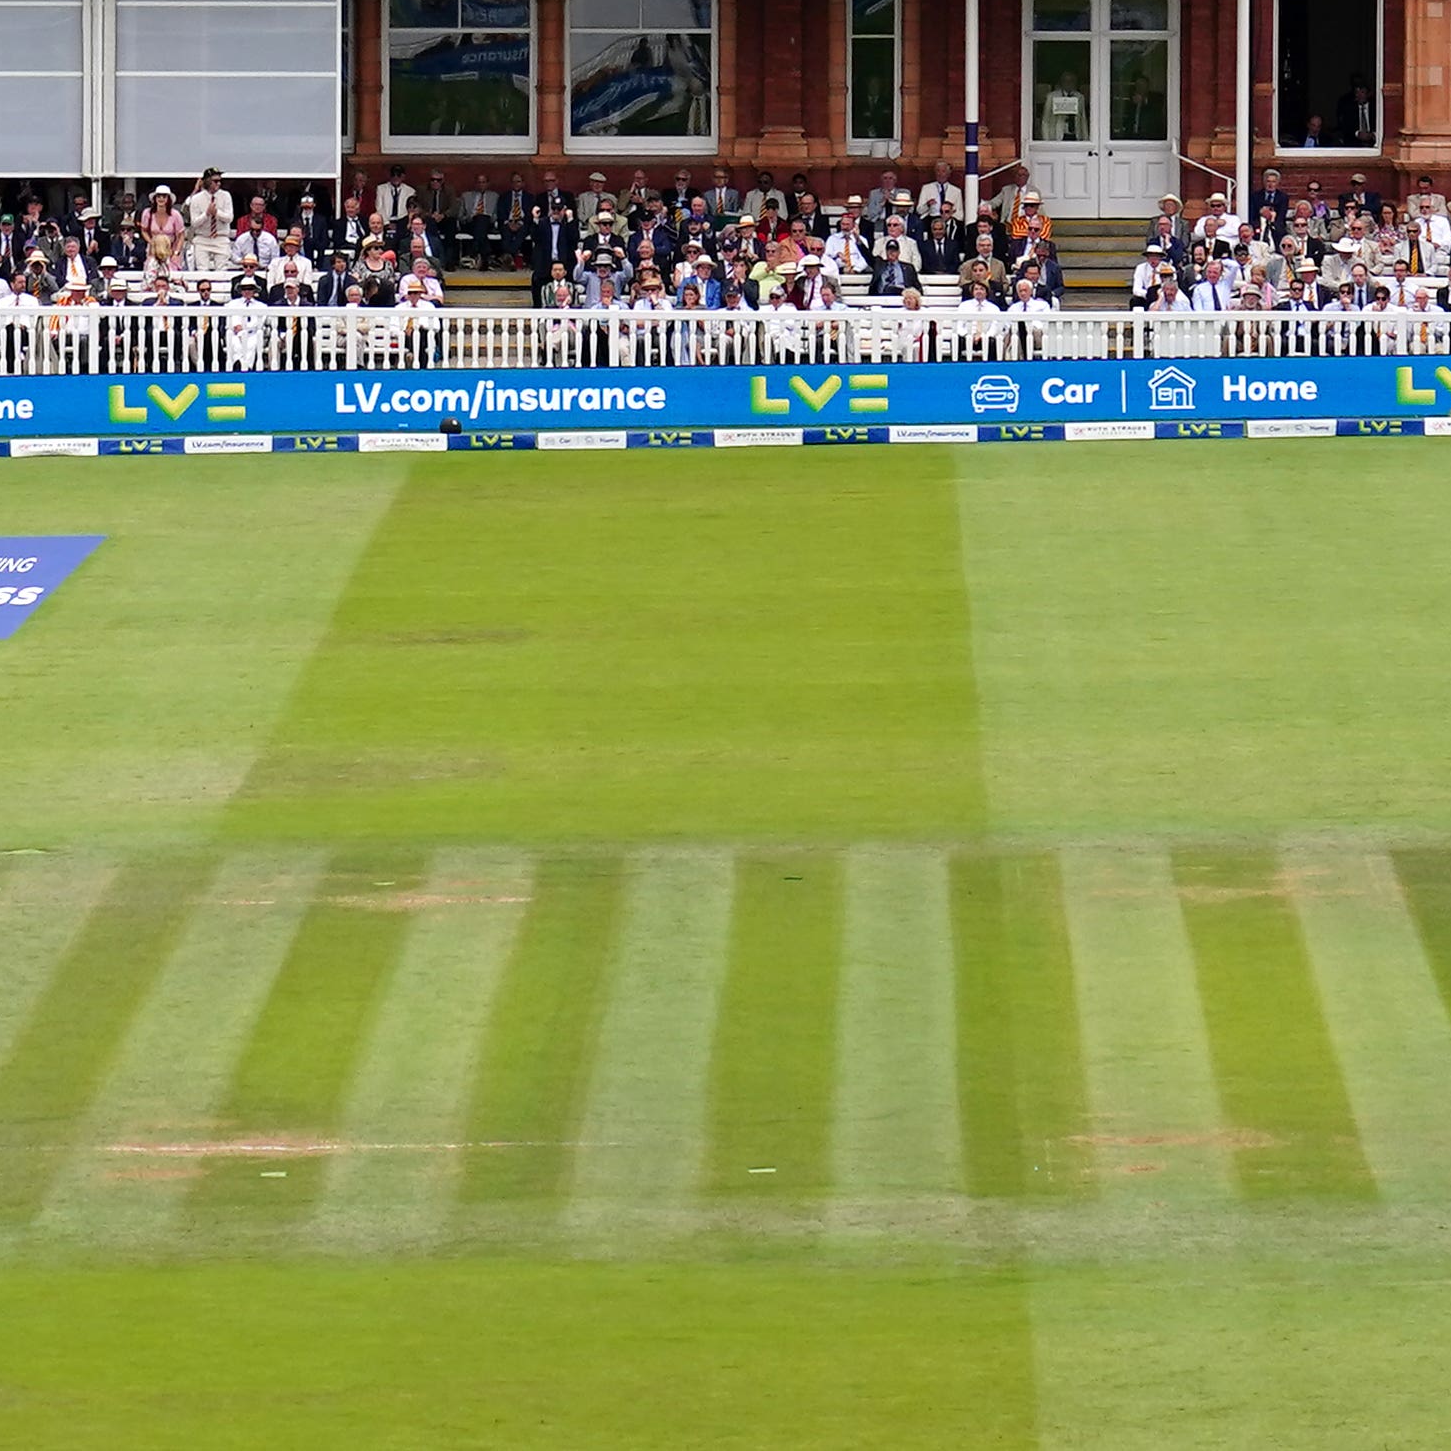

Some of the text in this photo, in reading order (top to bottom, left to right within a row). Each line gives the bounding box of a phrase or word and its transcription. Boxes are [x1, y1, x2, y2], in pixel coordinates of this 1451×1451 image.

[335, 380, 666, 419] LV.com/insurance
[1042, 378, 1099, 403] Car
[1224, 376, 1317, 401] Home
